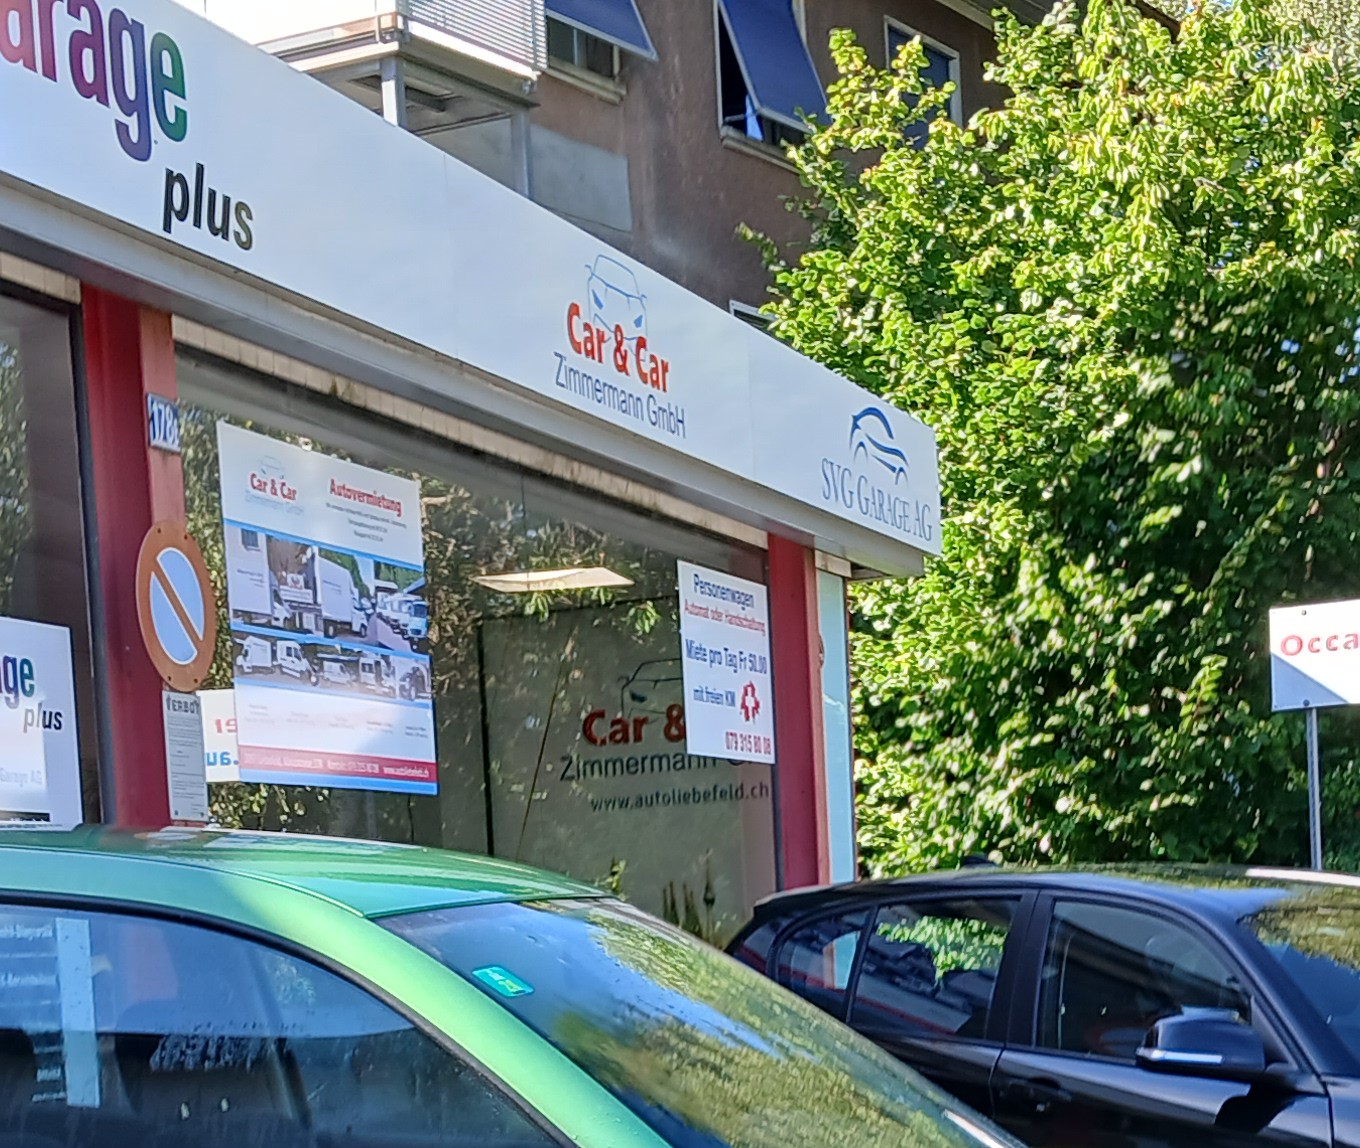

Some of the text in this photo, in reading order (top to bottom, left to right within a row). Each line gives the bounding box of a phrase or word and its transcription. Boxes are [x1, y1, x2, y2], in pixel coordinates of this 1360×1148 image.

[163, 162, 253, 250] plus
[567, 302, 669, 393] Car & Car
[554, 352, 686, 439] Zimmermann GmbH
[250, 473, 297, 500] Car & Car
[330, 478, 402, 517] Autovermietung
[822, 458, 932, 541] SVG GARAGE AG
[693, 574, 754, 611] Personenwagen
[685, 639, 707, 662] Miete
[709, 649, 722, 668] pro
[724, 647, 737, 673] Tag
[23, 702, 63, 733] plus
[582, 708, 648, 746] Car
[591, 781, 769, 812] www.autoliebefeld.ch
